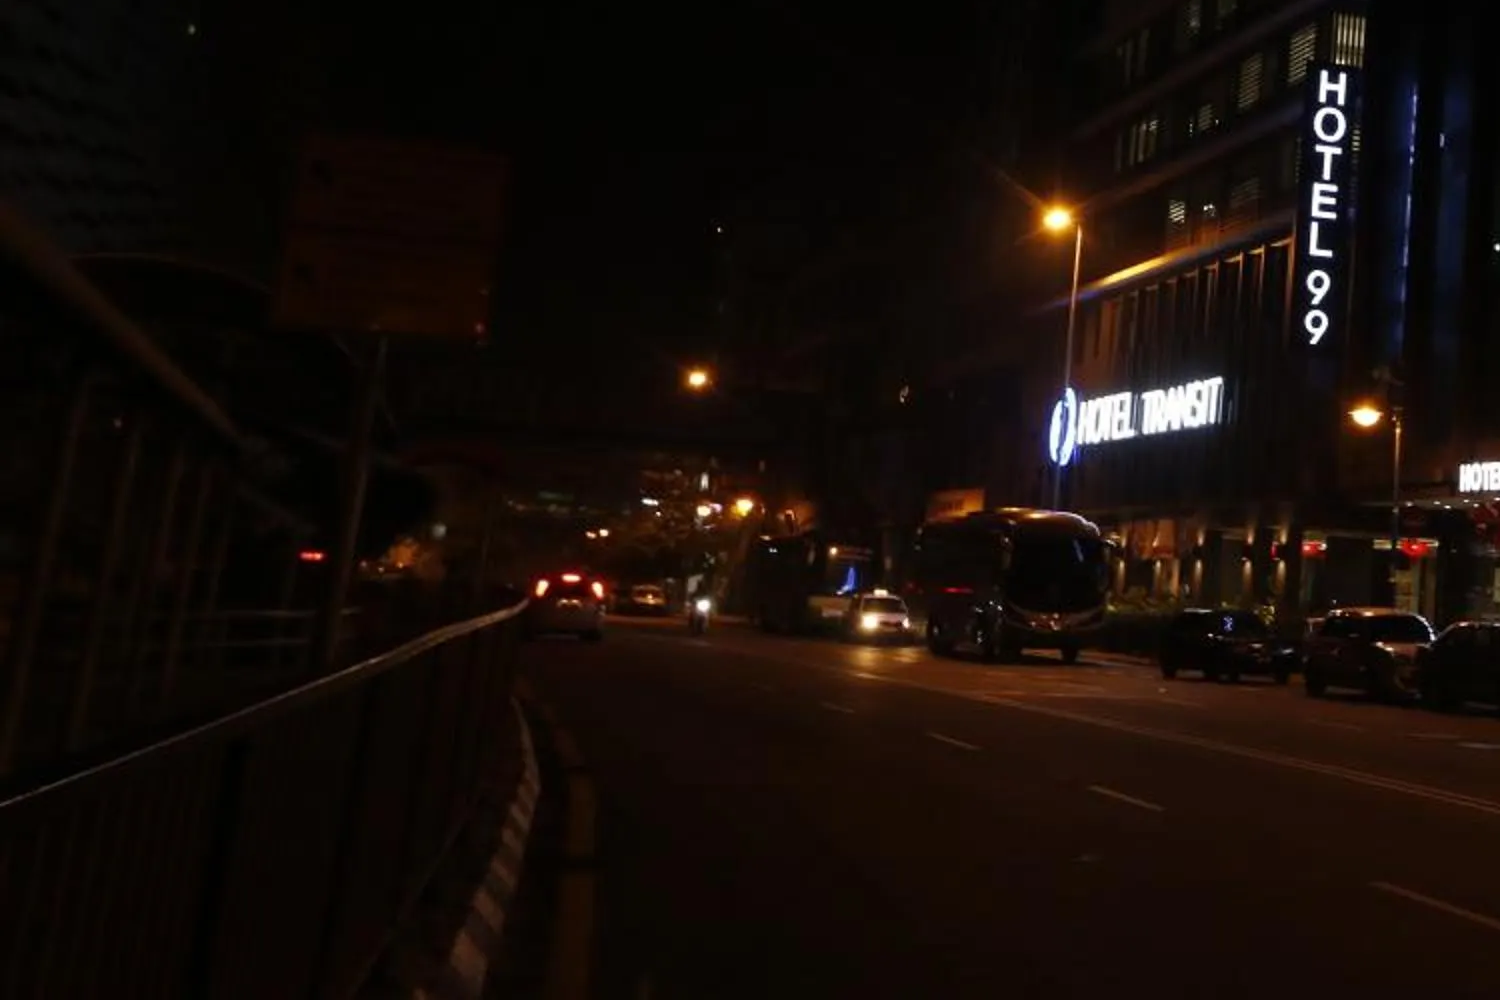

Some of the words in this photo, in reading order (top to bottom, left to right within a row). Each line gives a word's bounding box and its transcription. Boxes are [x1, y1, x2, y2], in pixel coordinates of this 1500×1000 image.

[1307, 68, 1348, 258] HOTEL
[1303, 268, 1332, 346] 99
[1076, 391, 1136, 445] HOTEL
[1141, 375, 1224, 435] TRANSIT
